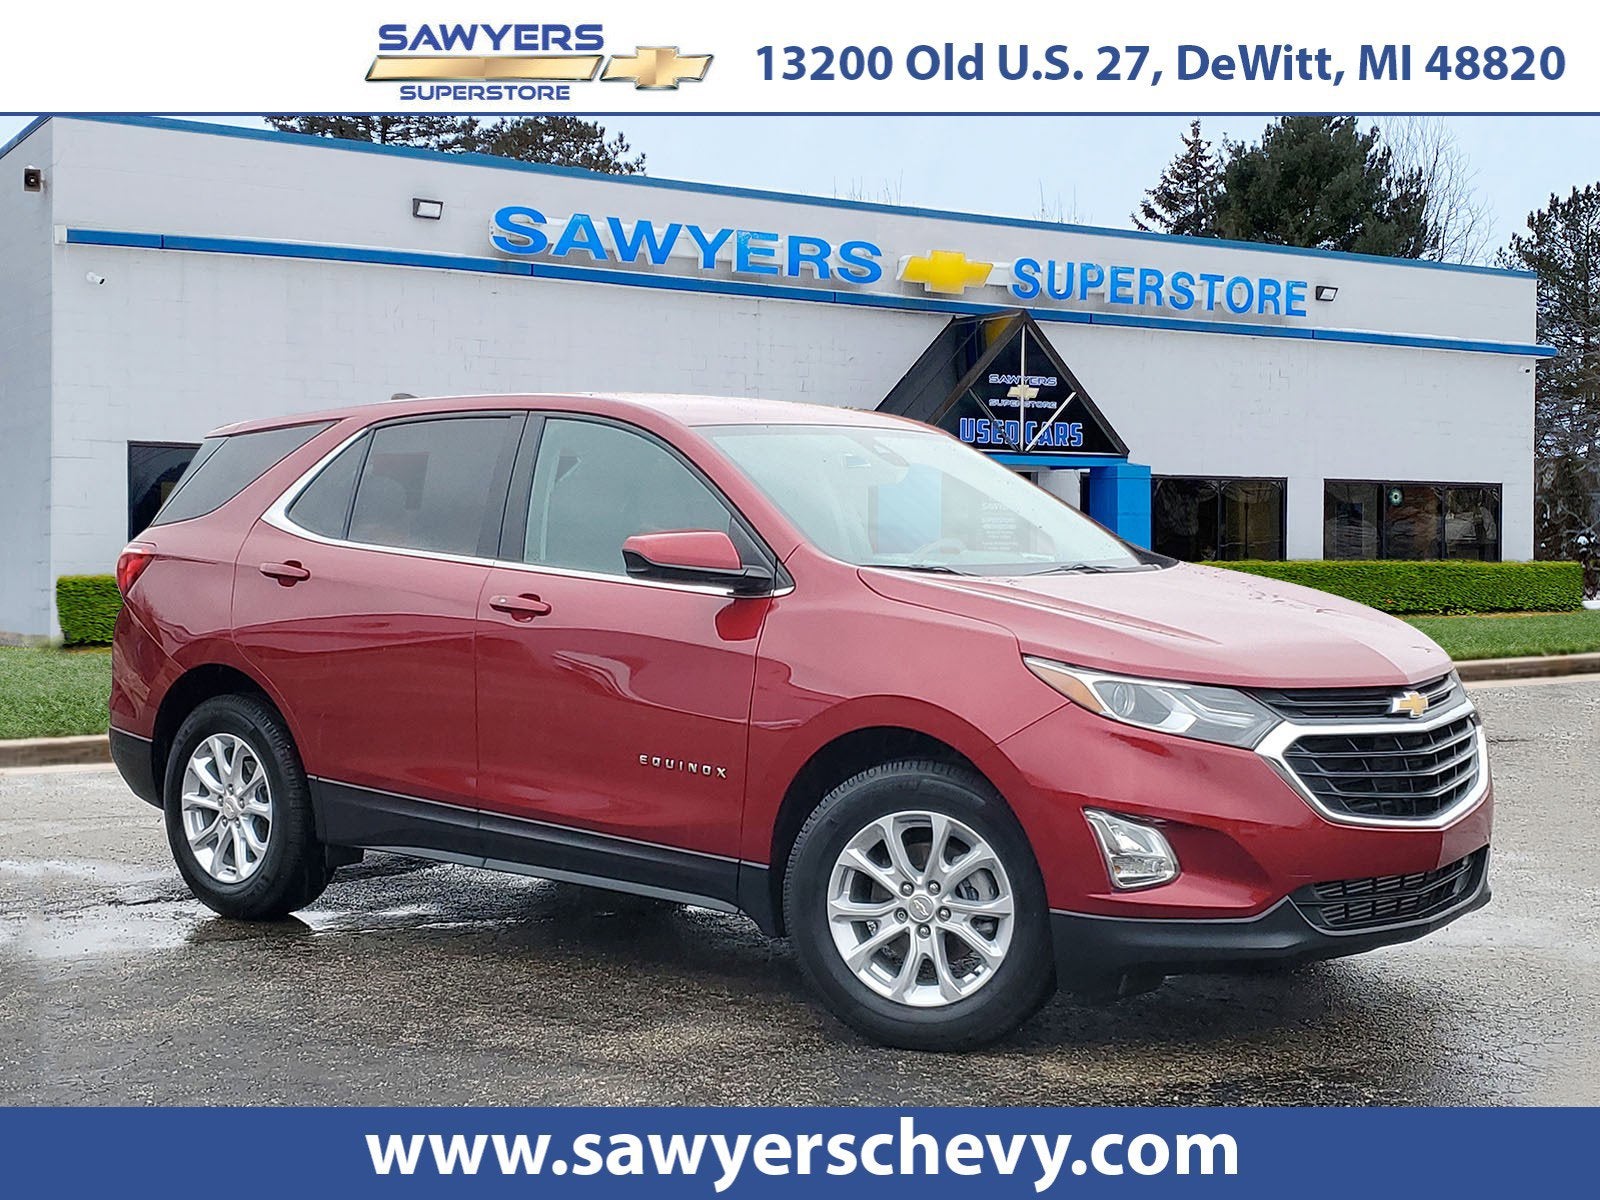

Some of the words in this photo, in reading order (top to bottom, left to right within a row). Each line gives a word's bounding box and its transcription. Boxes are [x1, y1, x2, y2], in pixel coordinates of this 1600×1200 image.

[491, 205, 883, 284] SAWYERS
[1010, 257, 1308, 317] SUPERSTORE
[989, 374, 1057, 386] SAWYERS
[959, 417, 1020, 445] USED
[1025, 420, 1084, 447] CARS
[639, 754, 727, 779] EQUINOX
